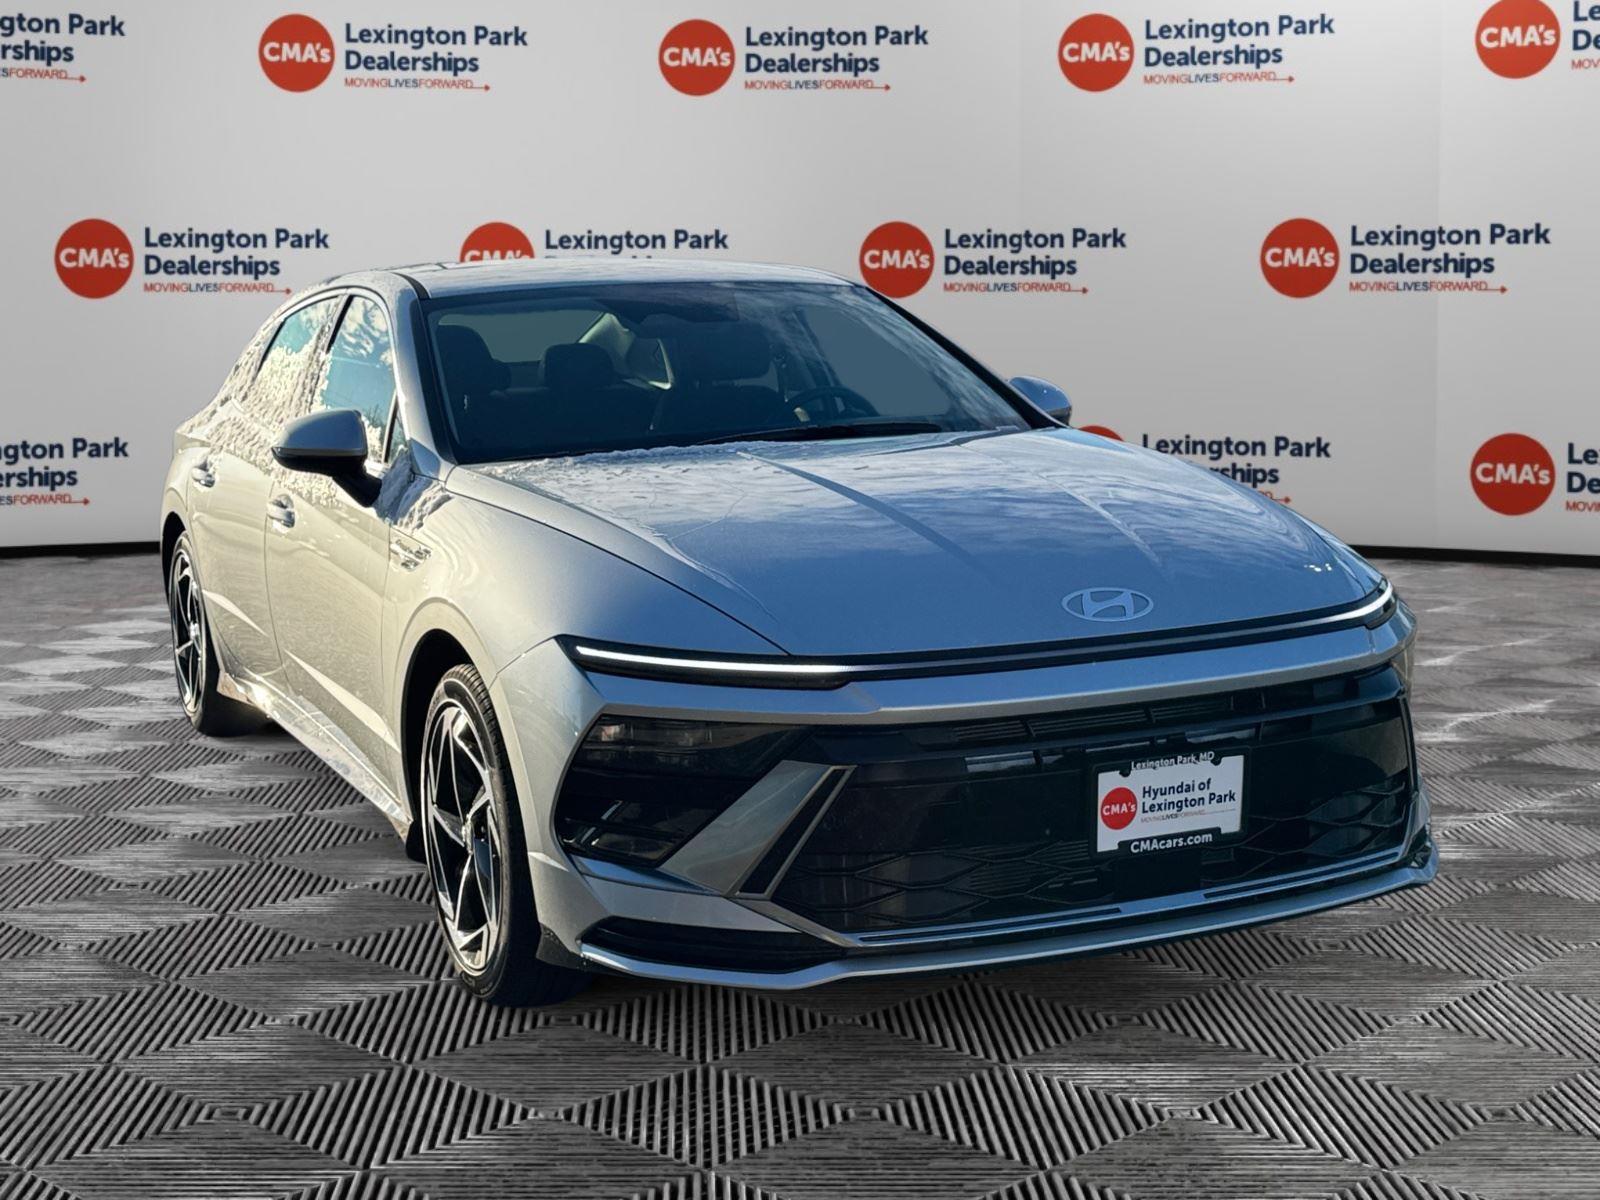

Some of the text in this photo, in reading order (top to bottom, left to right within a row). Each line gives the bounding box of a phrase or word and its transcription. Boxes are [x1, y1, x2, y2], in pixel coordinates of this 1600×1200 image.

[69, 13, 125, 36] Park
[345, 23, 528, 49] Lexington Park
[1145, 14, 1334, 43] Lexington Park
[1480, 24, 1556, 48] CMA's
[746, 25, 928, 50] Lexington Park
[263, 42, 331, 63] CMA's
[663, 47, 731, 66] CMA's
[1062, 41, 1130, 62] CMA's
[1144, 44, 1282, 69] Dealerships
[345, 51, 479, 76] Dealerships
[745, 53, 880, 77] Dealerships
[144, 227, 329, 253] Lexington Park
[546, 229, 728, 254] Lexington Park
[945, 228, 1126, 253] Lexington Park
[1351, 223, 1550, 250] Lexington Park
[59, 248, 129, 268] CMA's
[144, 255, 280, 280] Dealerships
[863, 249, 930, 268] CMA's
[944, 256, 1077, 279] Dealerships
[1265, 247, 1335, 267] CMA's
[1350, 252, 1494, 278] Dealerships
[73, 437, 128, 458] Park
[1275, 436, 1330, 458] Park
[1475, 462, 1551, 485] CMA's
[1131, 757, 1176, 770] Lexington
[1199, 751, 1215, 762] MD
[1142, 778, 1211, 800] Hyundai of
[1102, 802, 1136, 815] CMA's
[1142, 790, 1236, 814] Lexington Park
[1130, 833, 1213, 853] CMAcars.com
